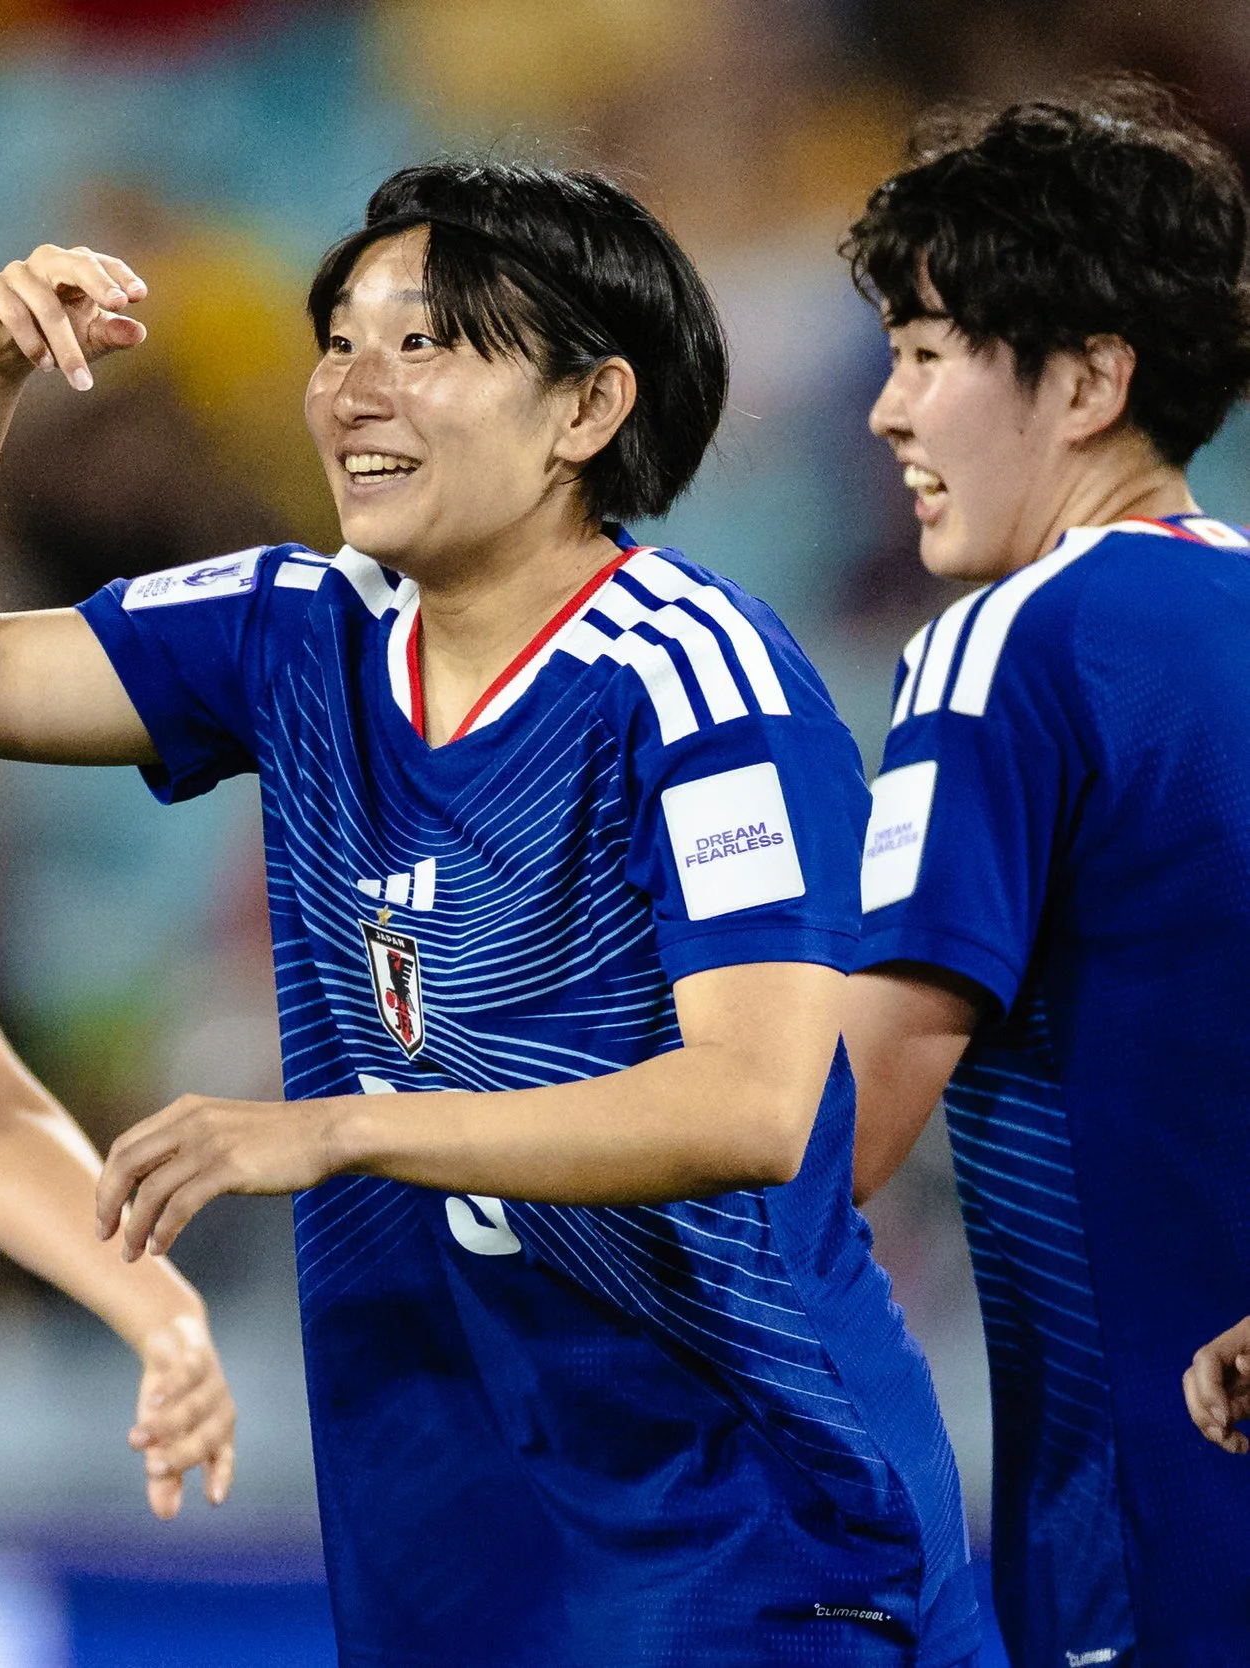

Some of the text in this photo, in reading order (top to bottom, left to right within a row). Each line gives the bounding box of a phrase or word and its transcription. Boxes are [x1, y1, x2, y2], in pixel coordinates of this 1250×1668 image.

[685, 832, 784, 868] FEARLESS
[695, 821, 767, 851] DREAM
[375, 930, 406, 949] JAPAN
